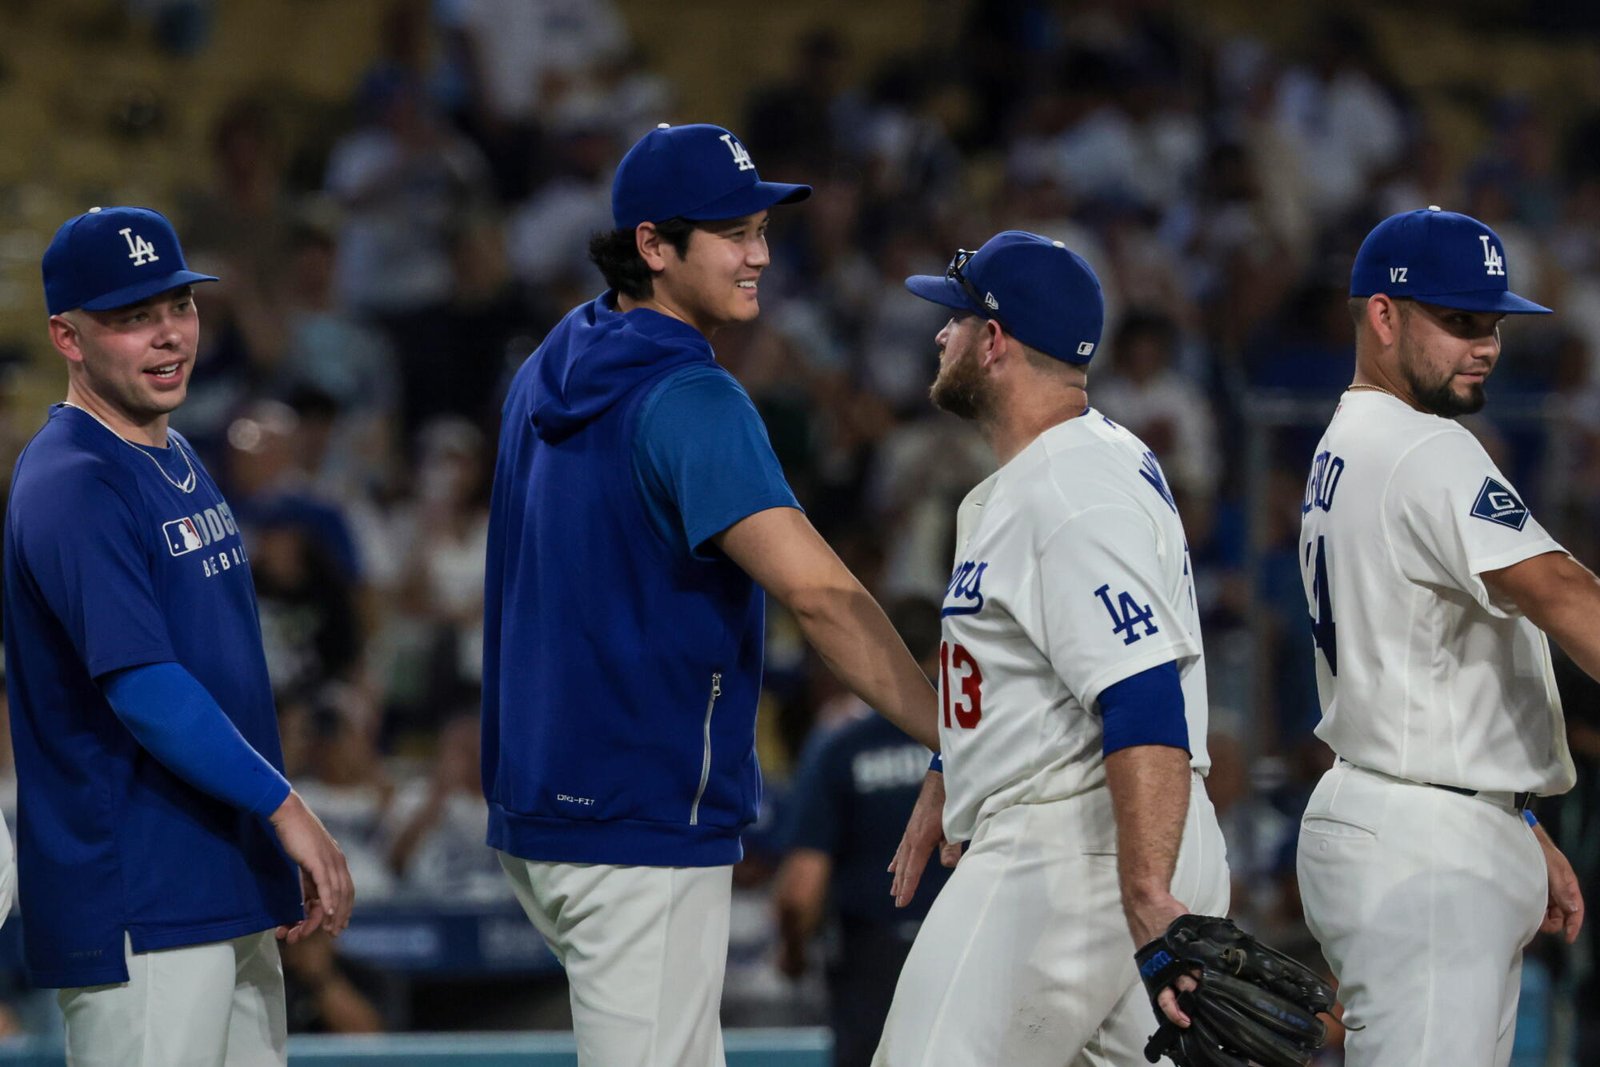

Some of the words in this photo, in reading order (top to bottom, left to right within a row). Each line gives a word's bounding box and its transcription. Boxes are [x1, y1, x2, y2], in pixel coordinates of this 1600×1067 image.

[718, 133, 755, 171] LA
[119, 227, 160, 267] LA
[1478, 235, 1505, 276] LA
[1389, 267, 1408, 283] VZ
[1487, 491, 1515, 511] G
[1094, 583, 1159, 646] LA
[938, 640, 983, 730] 13
